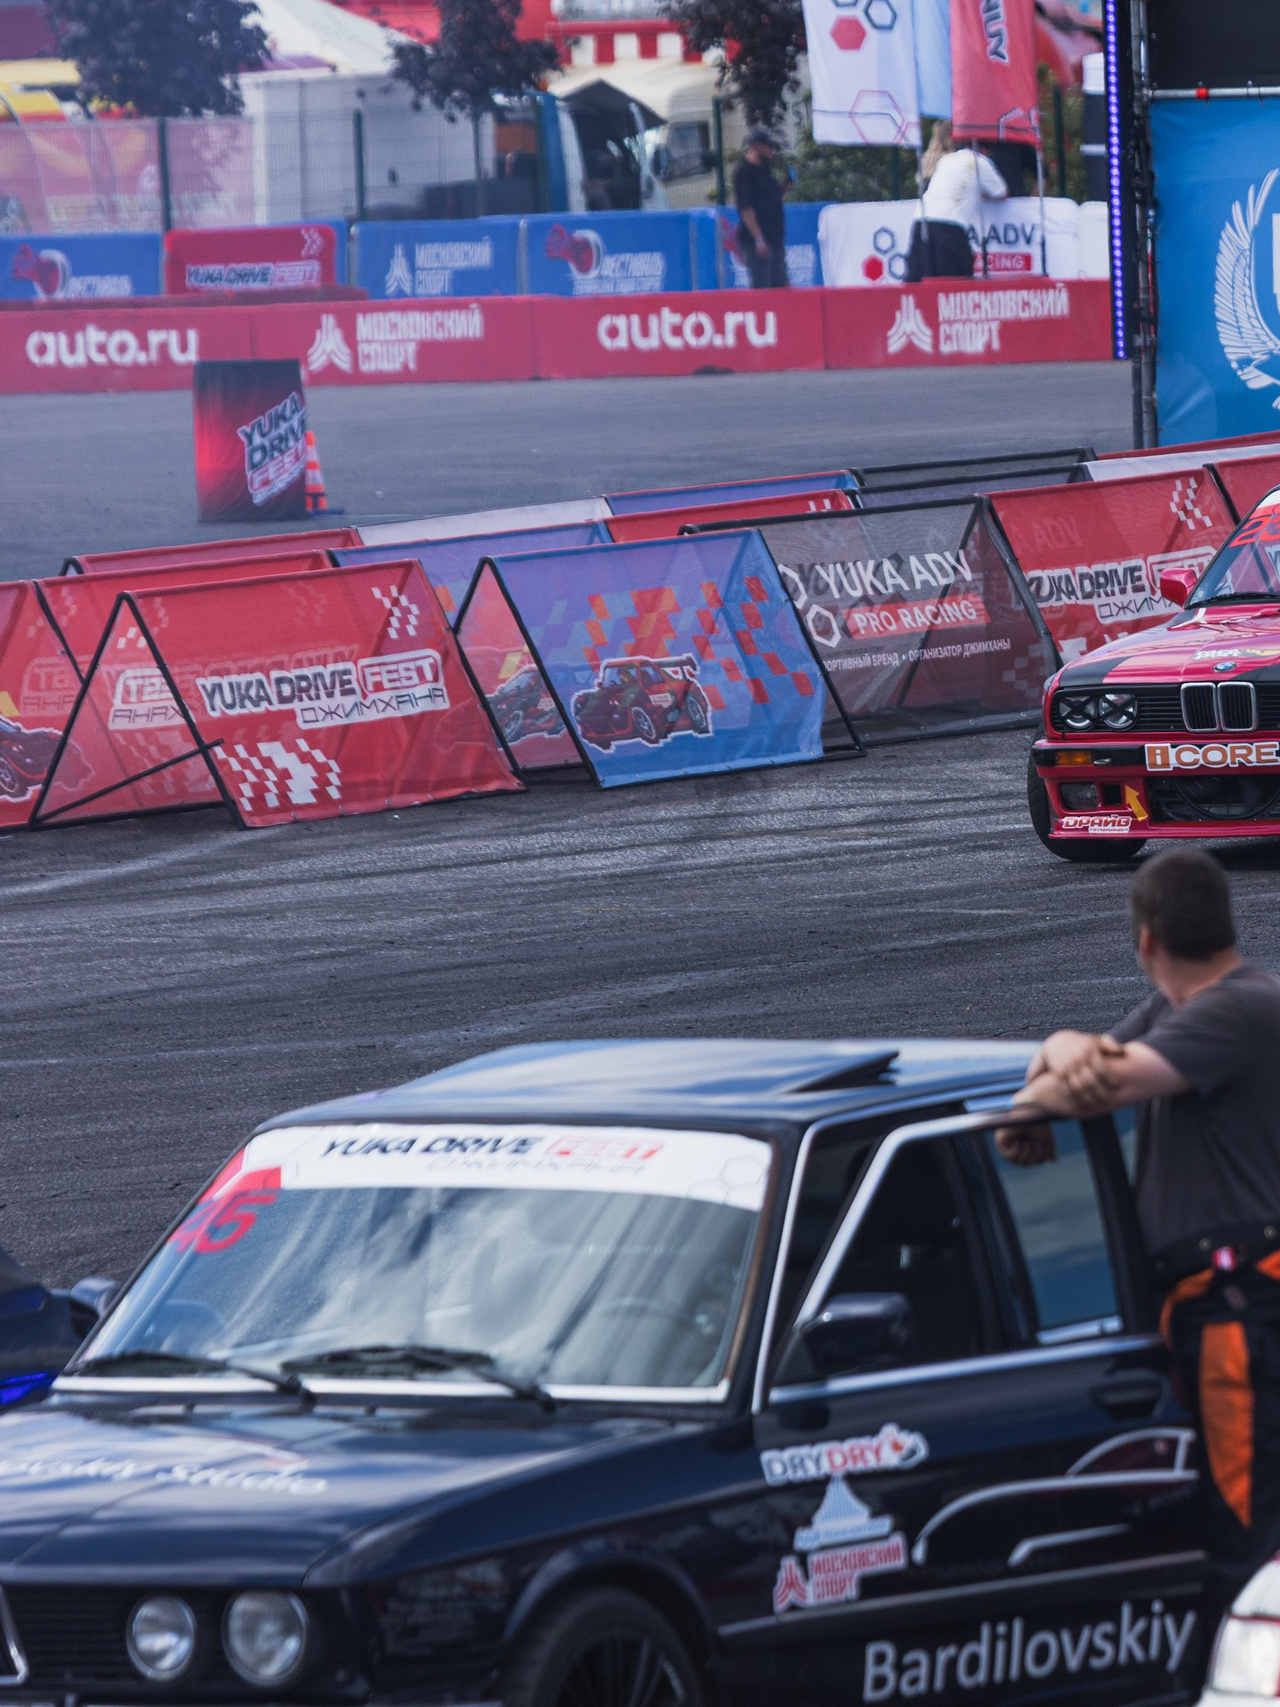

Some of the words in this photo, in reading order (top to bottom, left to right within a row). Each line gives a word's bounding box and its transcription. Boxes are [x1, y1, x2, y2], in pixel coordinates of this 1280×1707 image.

[986, 222, 1036, 246] ADV
[972, 254, 1026, 272] ACING
[937, 283, 1070, 322] МОСКОВСКИЙ
[357, 303, 485, 342] МОСКОВСКИЙ
[598, 306, 777, 352] auto.ru
[938, 320, 1001, 355] СПОРТ
[26, 323, 198, 367] auto.ru
[358, 341, 417, 373] СПОРТ
[814, 557, 910, 600] YUKA
[909, 549, 973, 590] ADV
[1077, 564, 1147, 600] DRIVE
[852, 608, 897, 635] PRO
[897, 599, 978, 630] RACING
[871, 652, 899, 668] БРЕНД
[908, 644, 963, 662] ОРГАНИЗАТОР
[962, 638, 1011, 657] ДЖИМХАНЫ
[199, 677, 273, 712] YUKA
[273, 668, 357, 704] DRIVE
[362, 658, 436, 691] FEST
[300, 687, 447, 725] ДЖИМХАНА
[1063, 815, 1131, 829] ДРАЙВ
[321, 1137, 418, 1158] YUKA
[419, 1136, 545, 1154] DRIVE
[766, 1442, 883, 1479] DRYDRY
[810, 1541, 902, 1575] МОСКОВСКИЙ
[812, 1572, 856, 1600] СПОРТ
[862, 1600, 1198, 1703] Bardilovskiy
